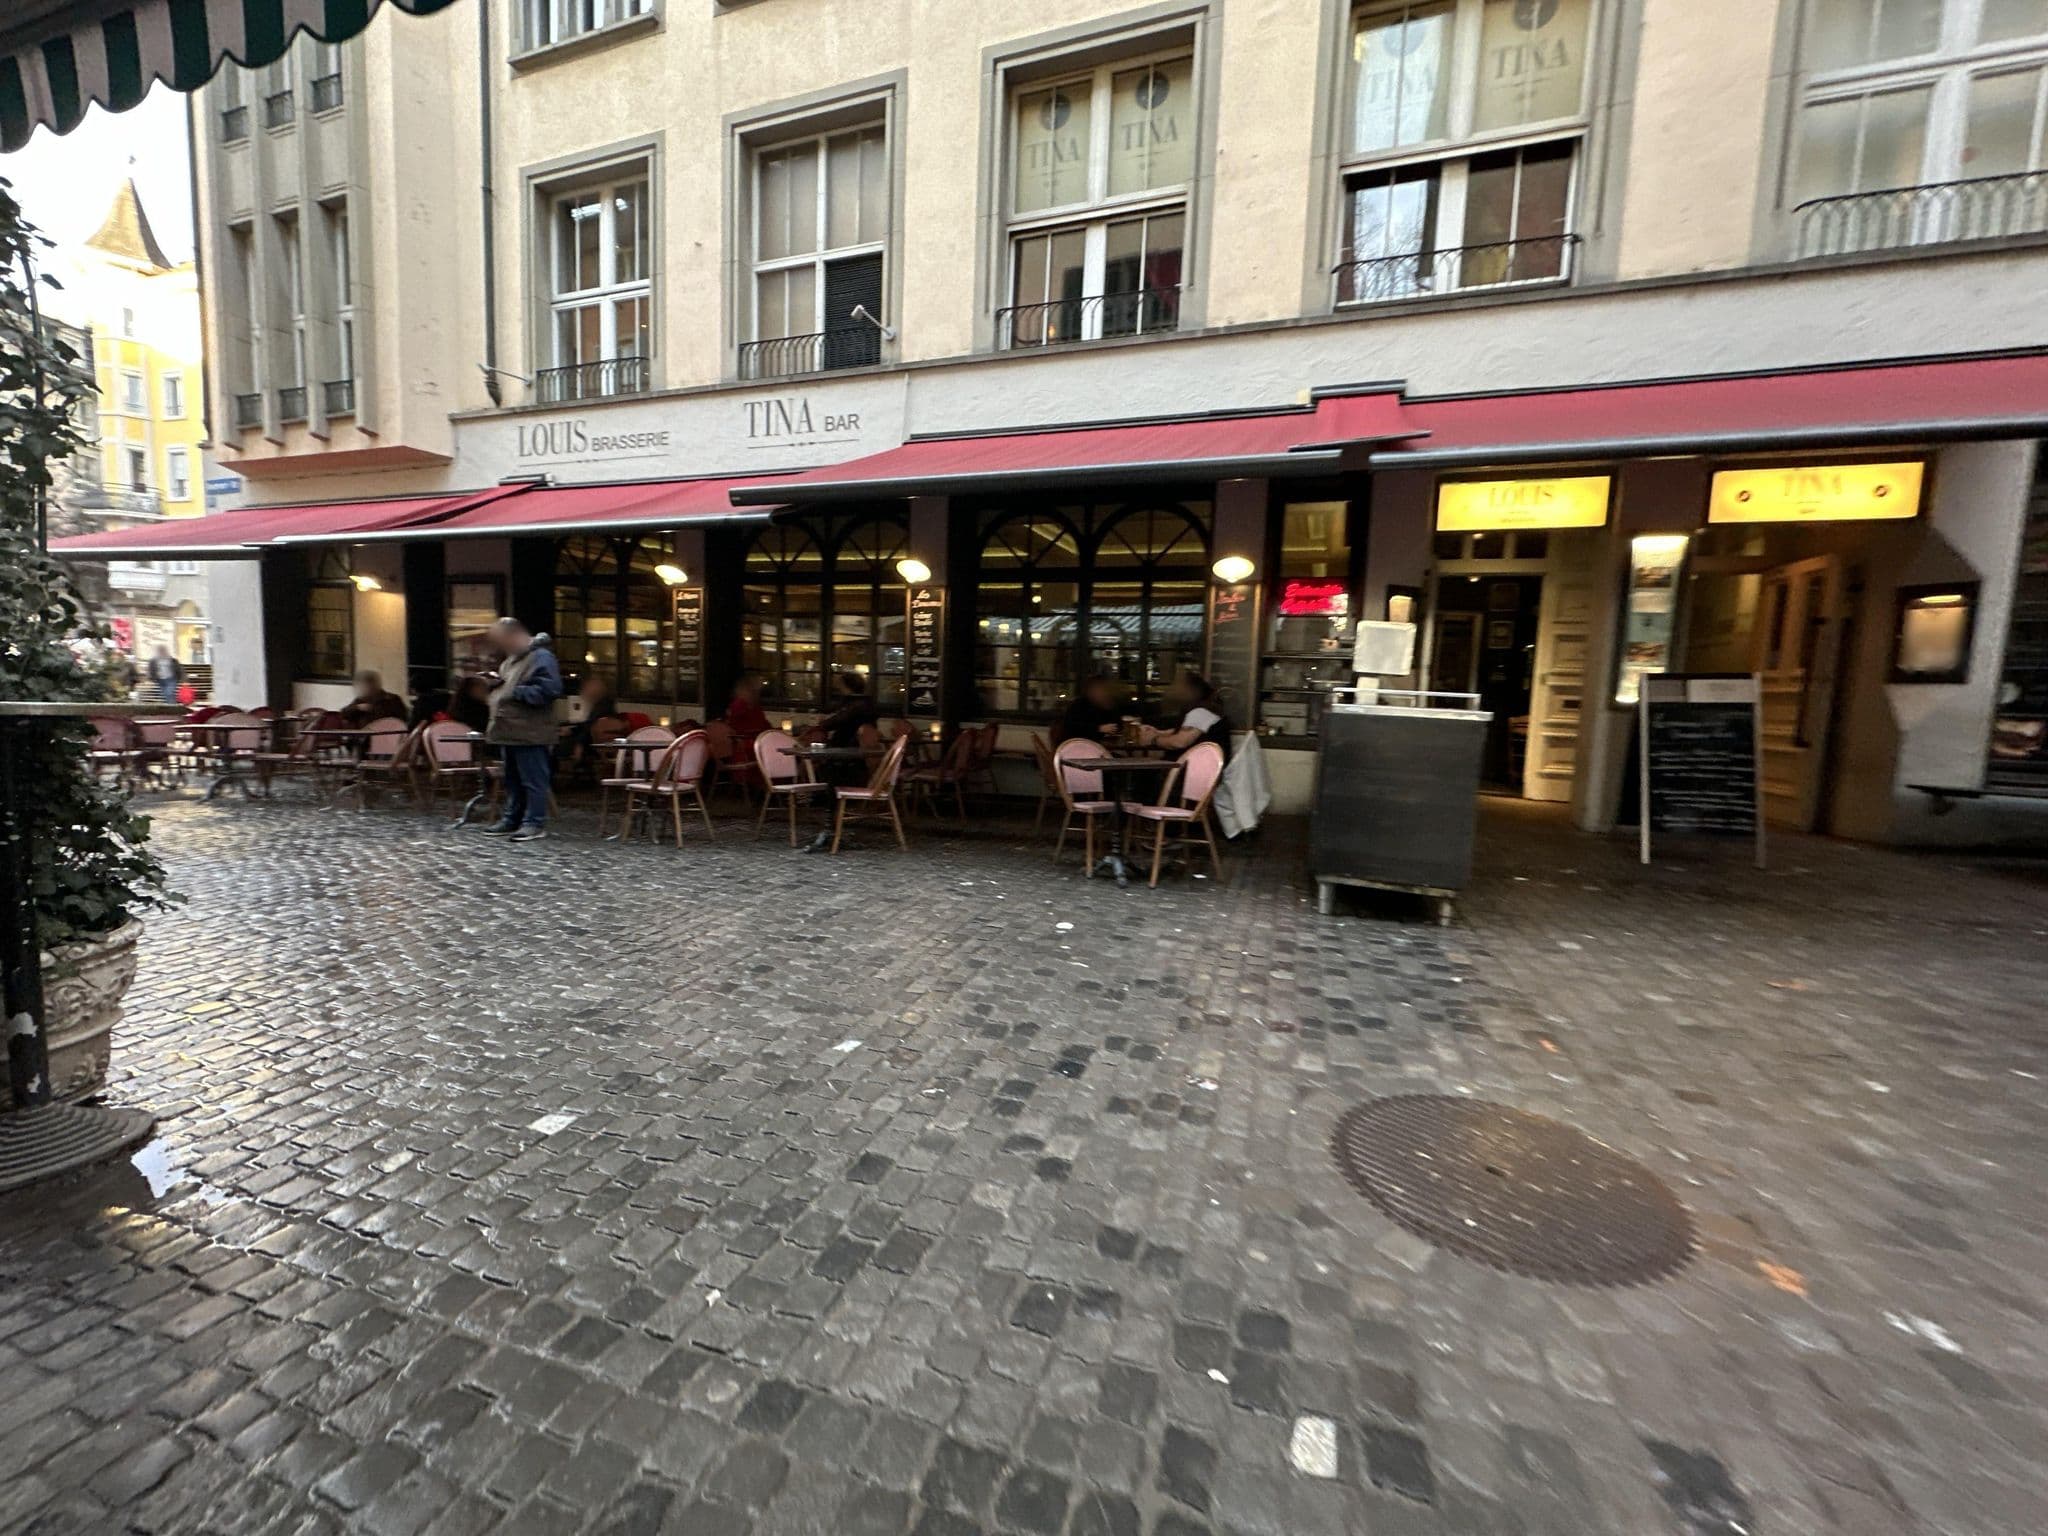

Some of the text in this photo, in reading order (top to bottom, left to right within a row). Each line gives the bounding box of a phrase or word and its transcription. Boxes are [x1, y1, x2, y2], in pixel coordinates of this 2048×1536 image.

[1121, 115, 1178, 151] TINA
[1024, 137, 1081, 169] TINA
[743, 398, 861, 438] TINA BAR
[517, 420, 671, 458] LOUIS BRASSERIE
